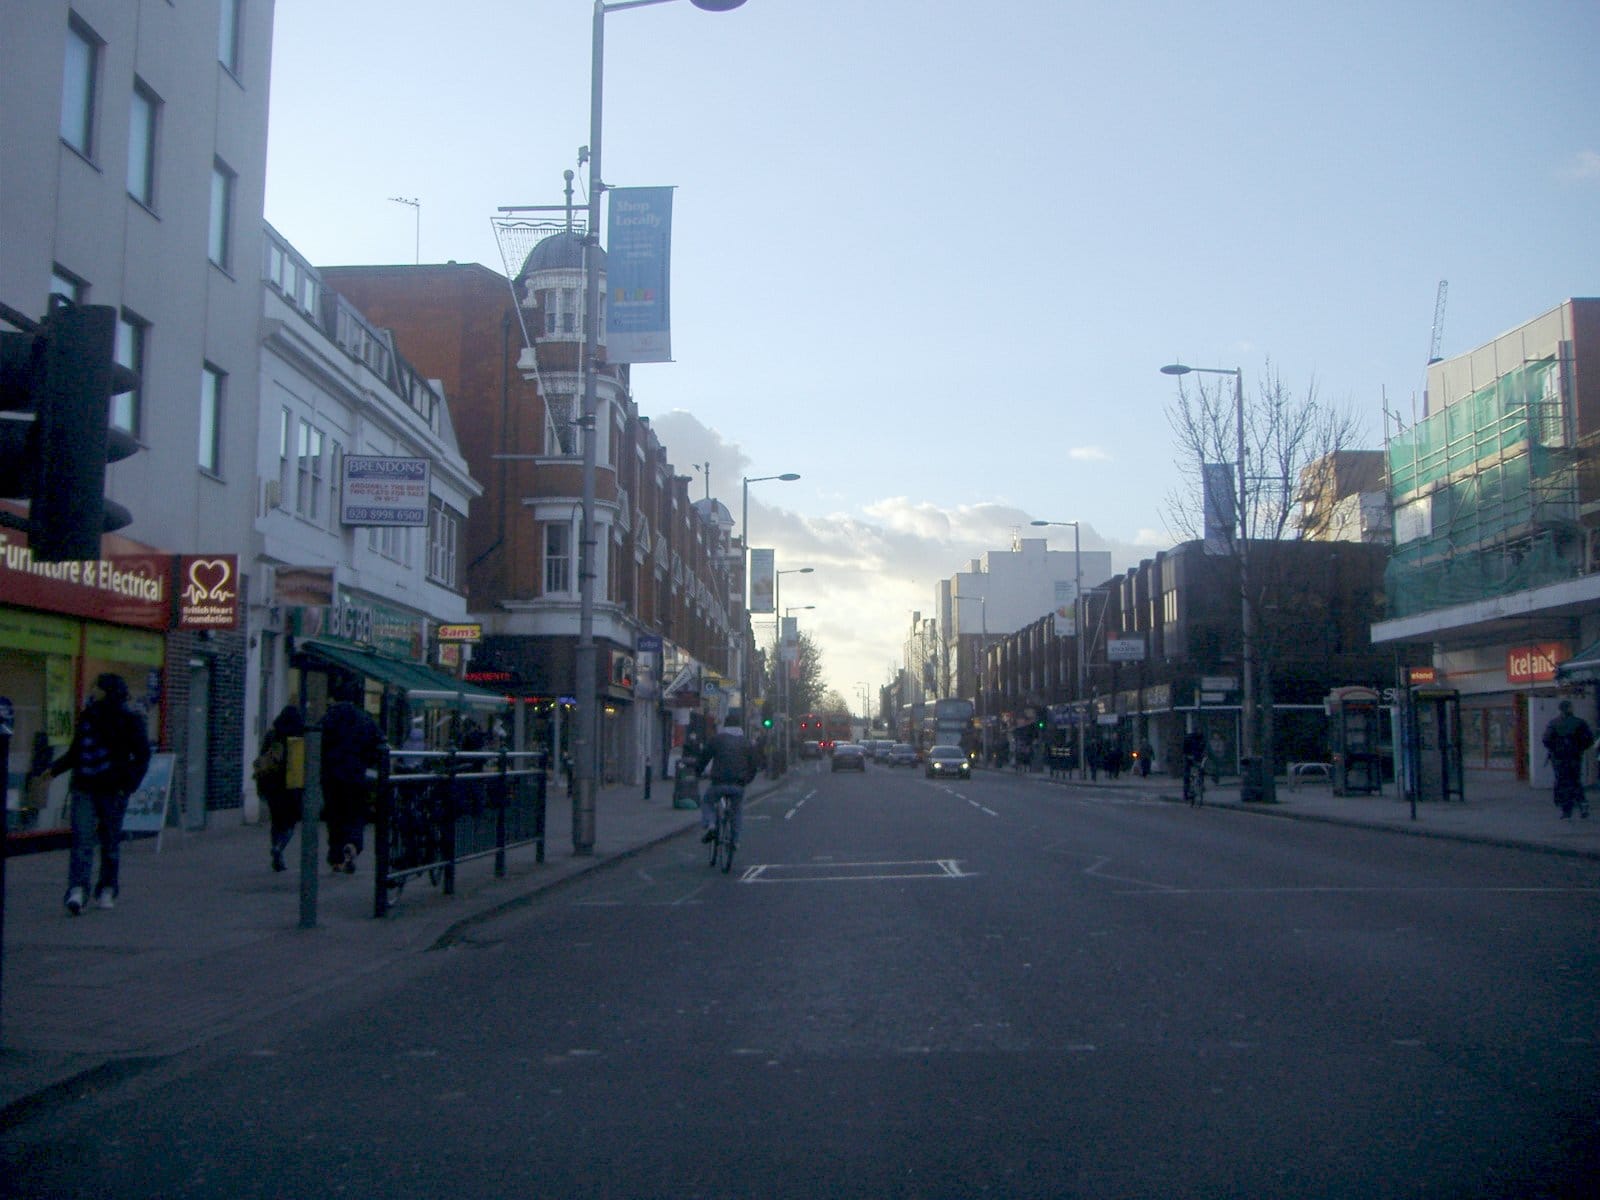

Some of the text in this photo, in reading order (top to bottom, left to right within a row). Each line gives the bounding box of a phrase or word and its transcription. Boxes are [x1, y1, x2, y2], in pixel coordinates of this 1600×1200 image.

[615, 201, 650, 214] Shop
[615, 213, 661, 228] Locally
[349, 460, 423, 473] BRENDONS
[99, 559, 163, 602] Electrical
[182, 605, 233, 615] British Heart
[182, 615, 233, 624] Foundation
[1510, 649, 1556, 676] Iceland
